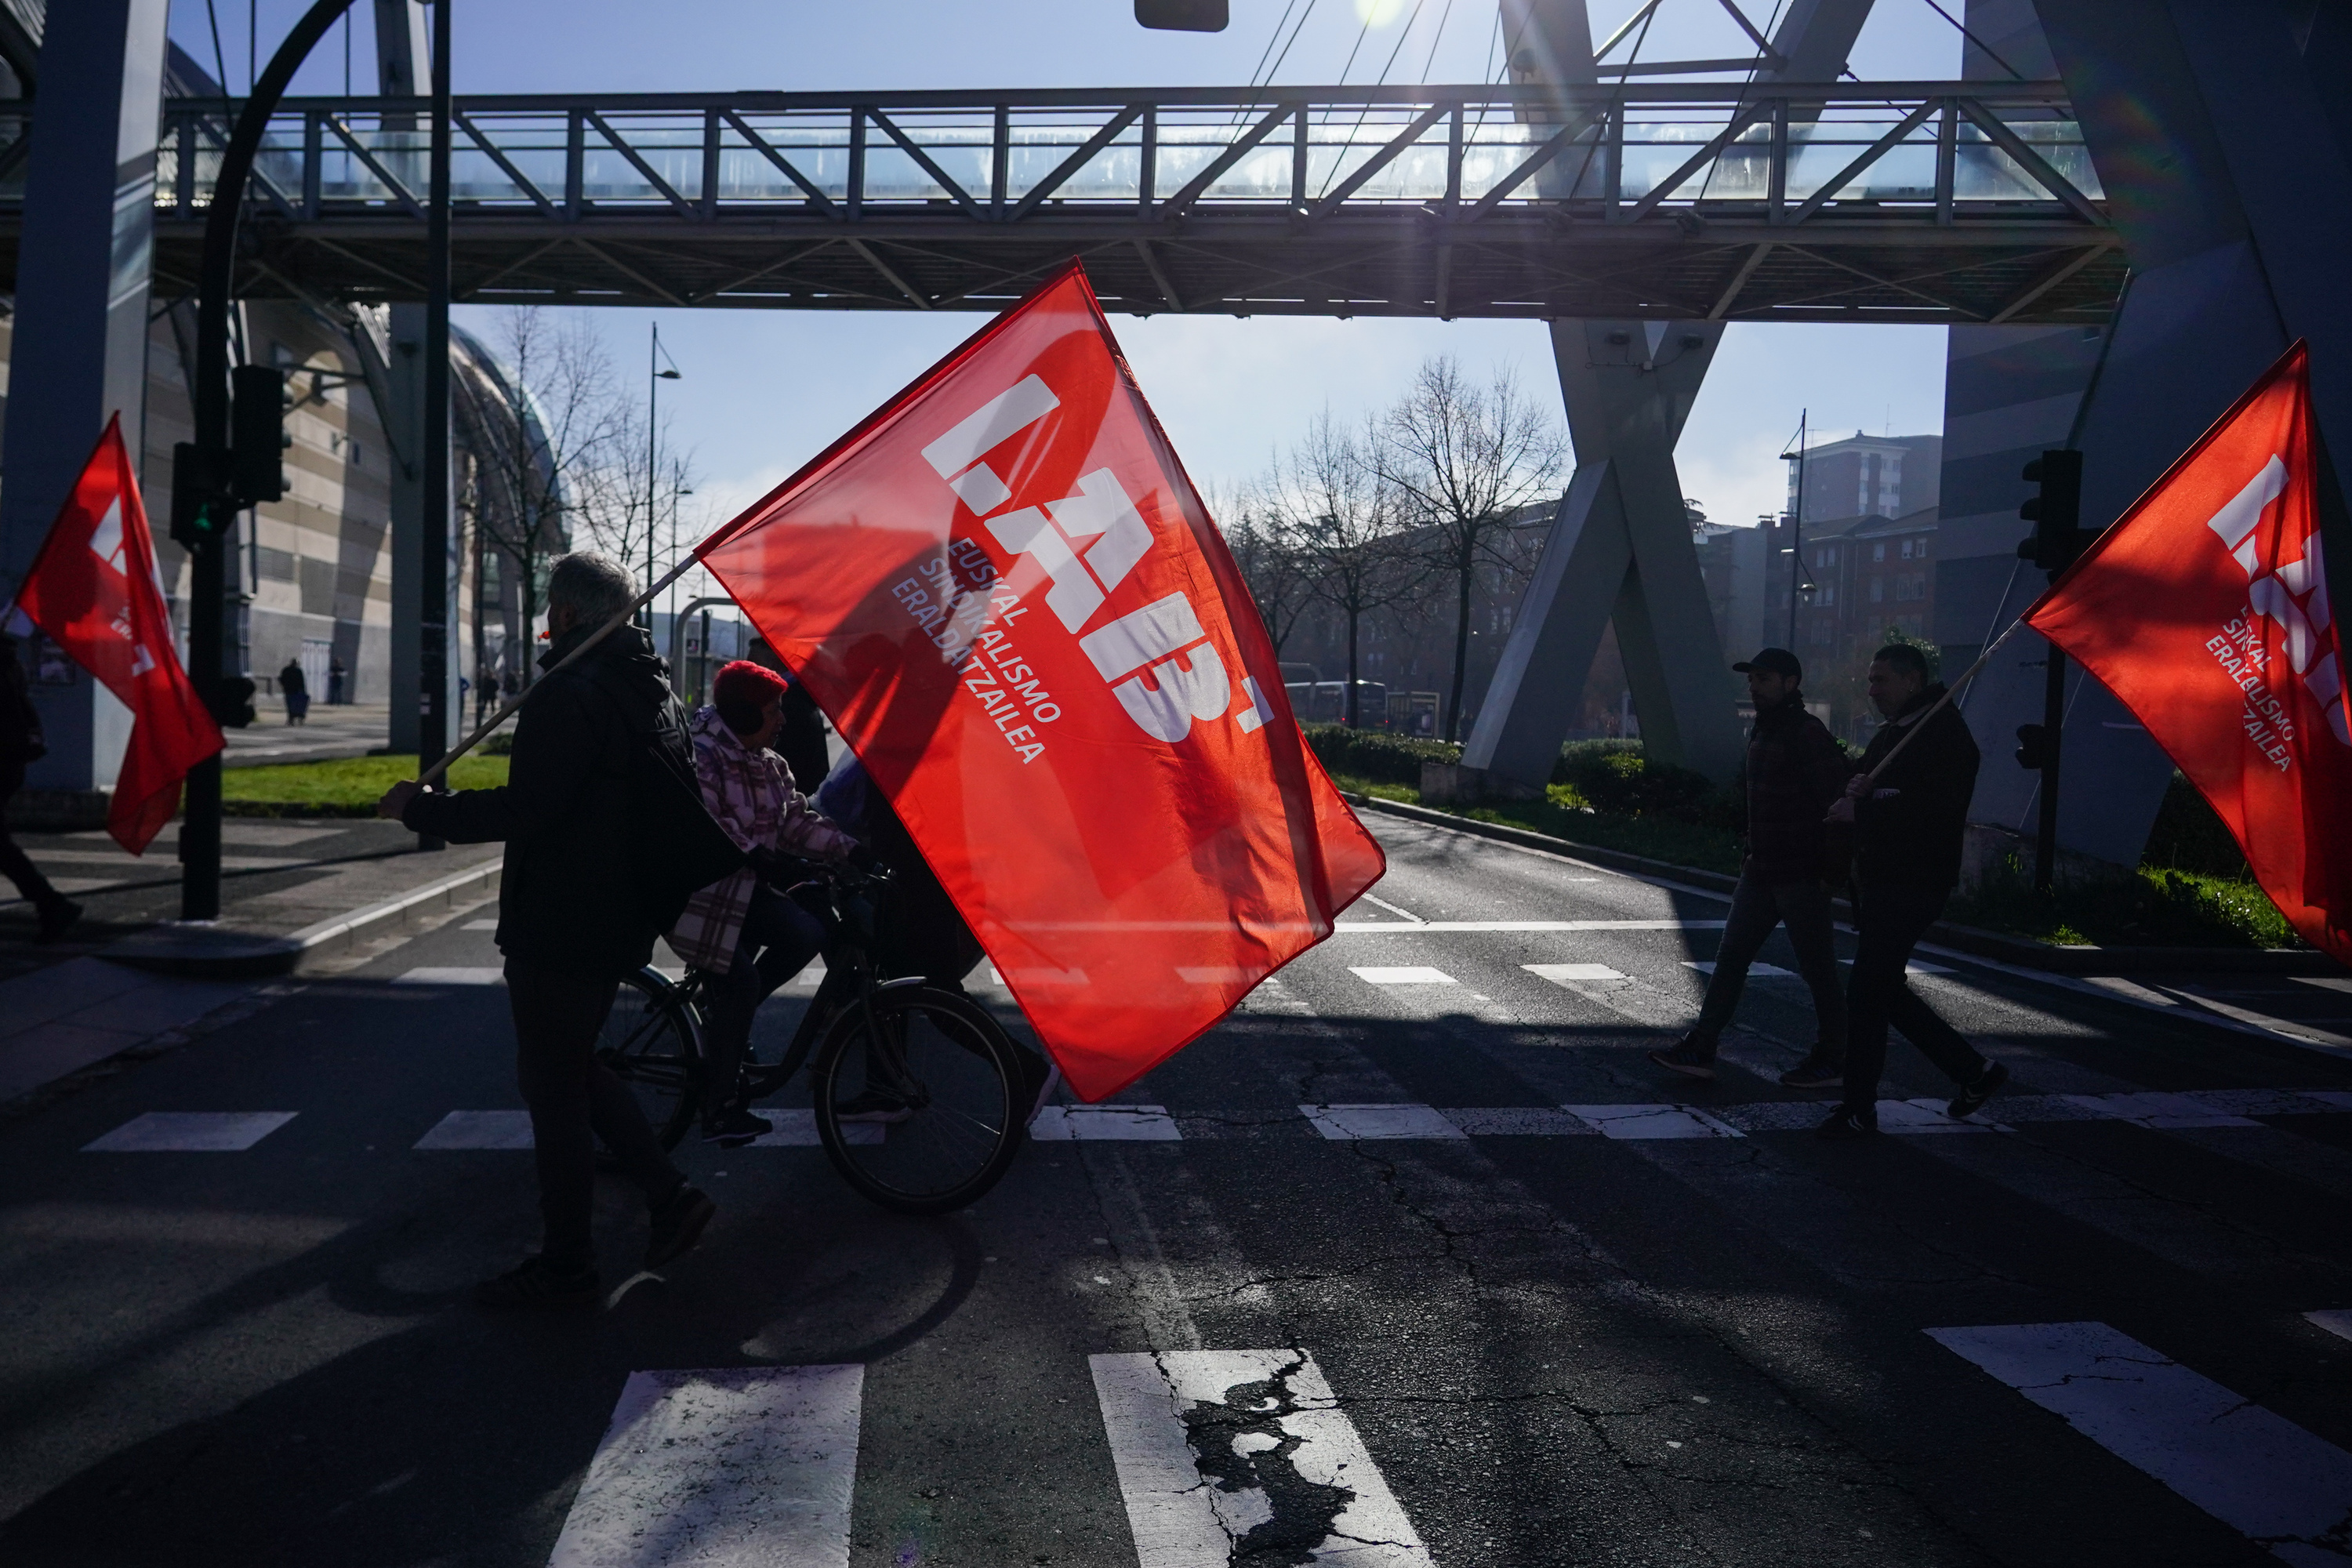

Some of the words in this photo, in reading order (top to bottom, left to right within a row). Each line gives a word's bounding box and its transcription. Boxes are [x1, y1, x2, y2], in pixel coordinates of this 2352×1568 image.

[919, 557, 1062, 724] SINDIKALISMO
[921, 373, 1230, 743] LAB
[949, 537, 1029, 627] EUSKAL
[891, 577, 1046, 764] ERALDATZAILEA
